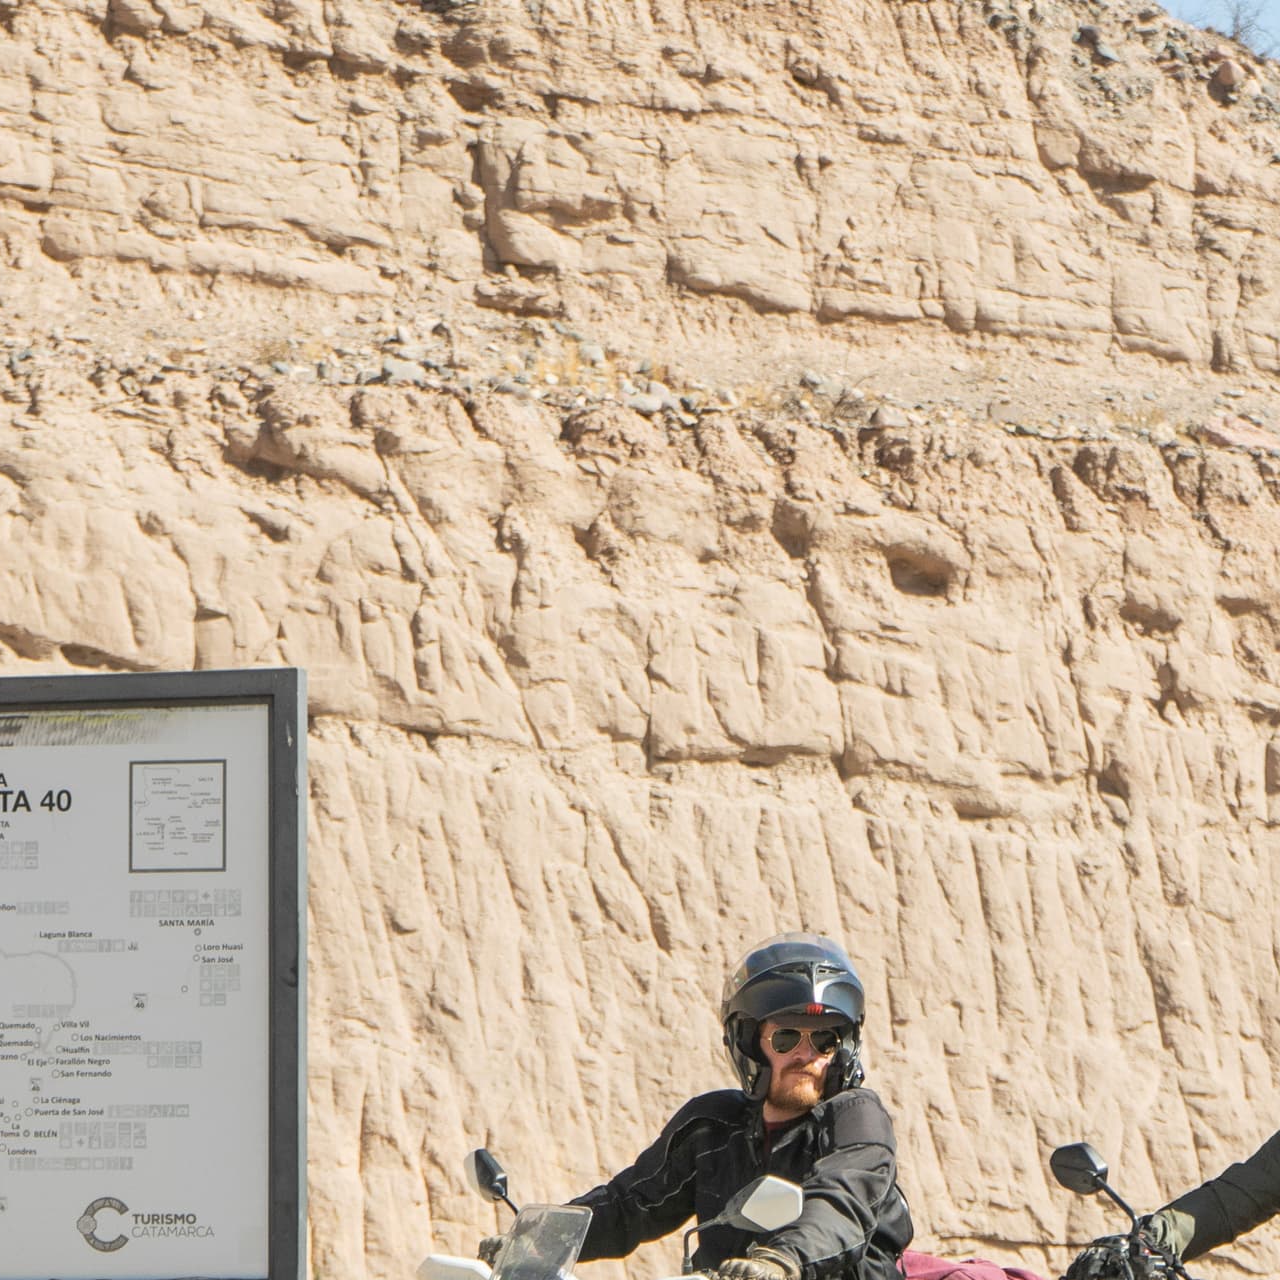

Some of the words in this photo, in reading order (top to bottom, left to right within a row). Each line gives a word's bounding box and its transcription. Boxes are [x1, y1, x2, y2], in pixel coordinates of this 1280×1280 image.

[40, 789, 72, 812] 40
[187, 918, 214, 926] MARÍA
[40, 931, 66, 939] Laguna
[68, 930, 92, 938] Blanca
[222, 943, 243, 951] Huasi
[36, 1059, 48, 1067] Eje
[88, 1058, 110, 1066] Negro
[51, 1096, 81, 1105] Ciénaga
[63, 1108, 71, 1116] de
[73, 1108, 86, 1116] San
[88, 1108, 104, 1116] José
[34, 1129, 57, 1138] BELÉN
[132, 1213, 197, 1225] TURISMO
[131, 1226, 216, 1238] CATAMARCA
